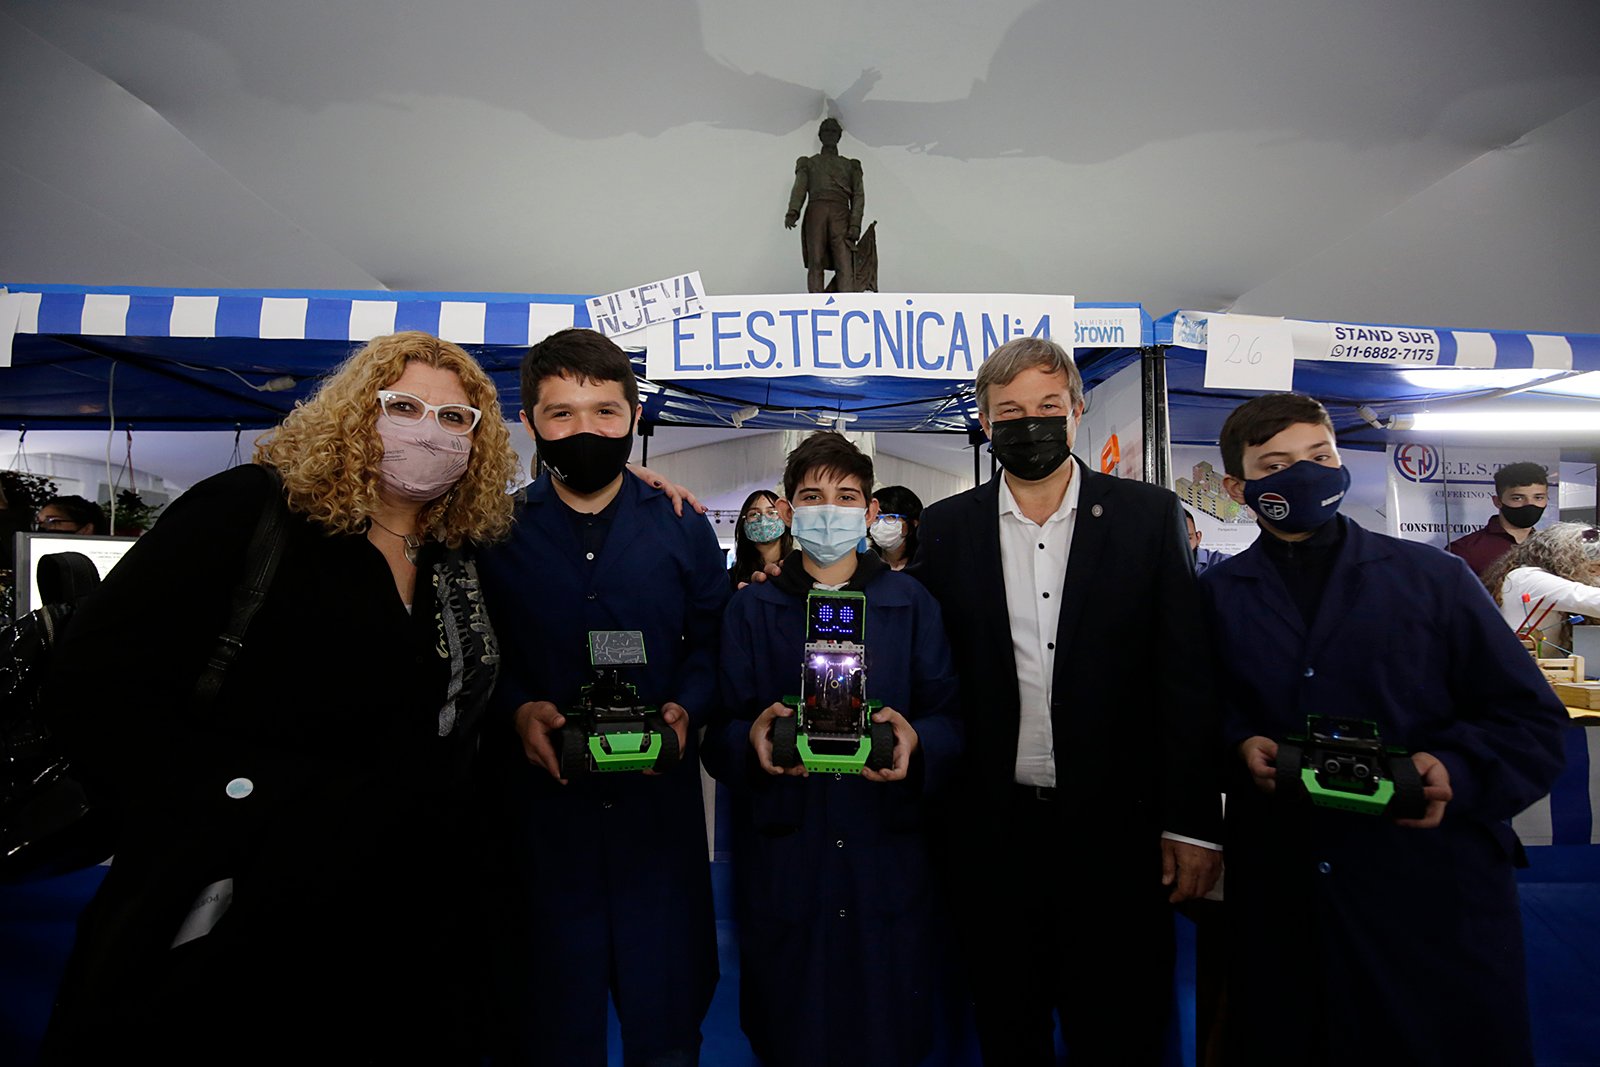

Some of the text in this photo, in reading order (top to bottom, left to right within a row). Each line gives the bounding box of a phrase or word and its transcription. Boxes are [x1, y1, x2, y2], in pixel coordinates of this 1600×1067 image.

[593, 276, 704, 337] NUEVA
[1335, 326, 1435, 344] STAND SUR
[1225, 333, 1263, 365] 26
[1346, 346, 1434, 361] 11-6882-7175
[1400, 522, 1487, 534] CONSTRUCCIONE
